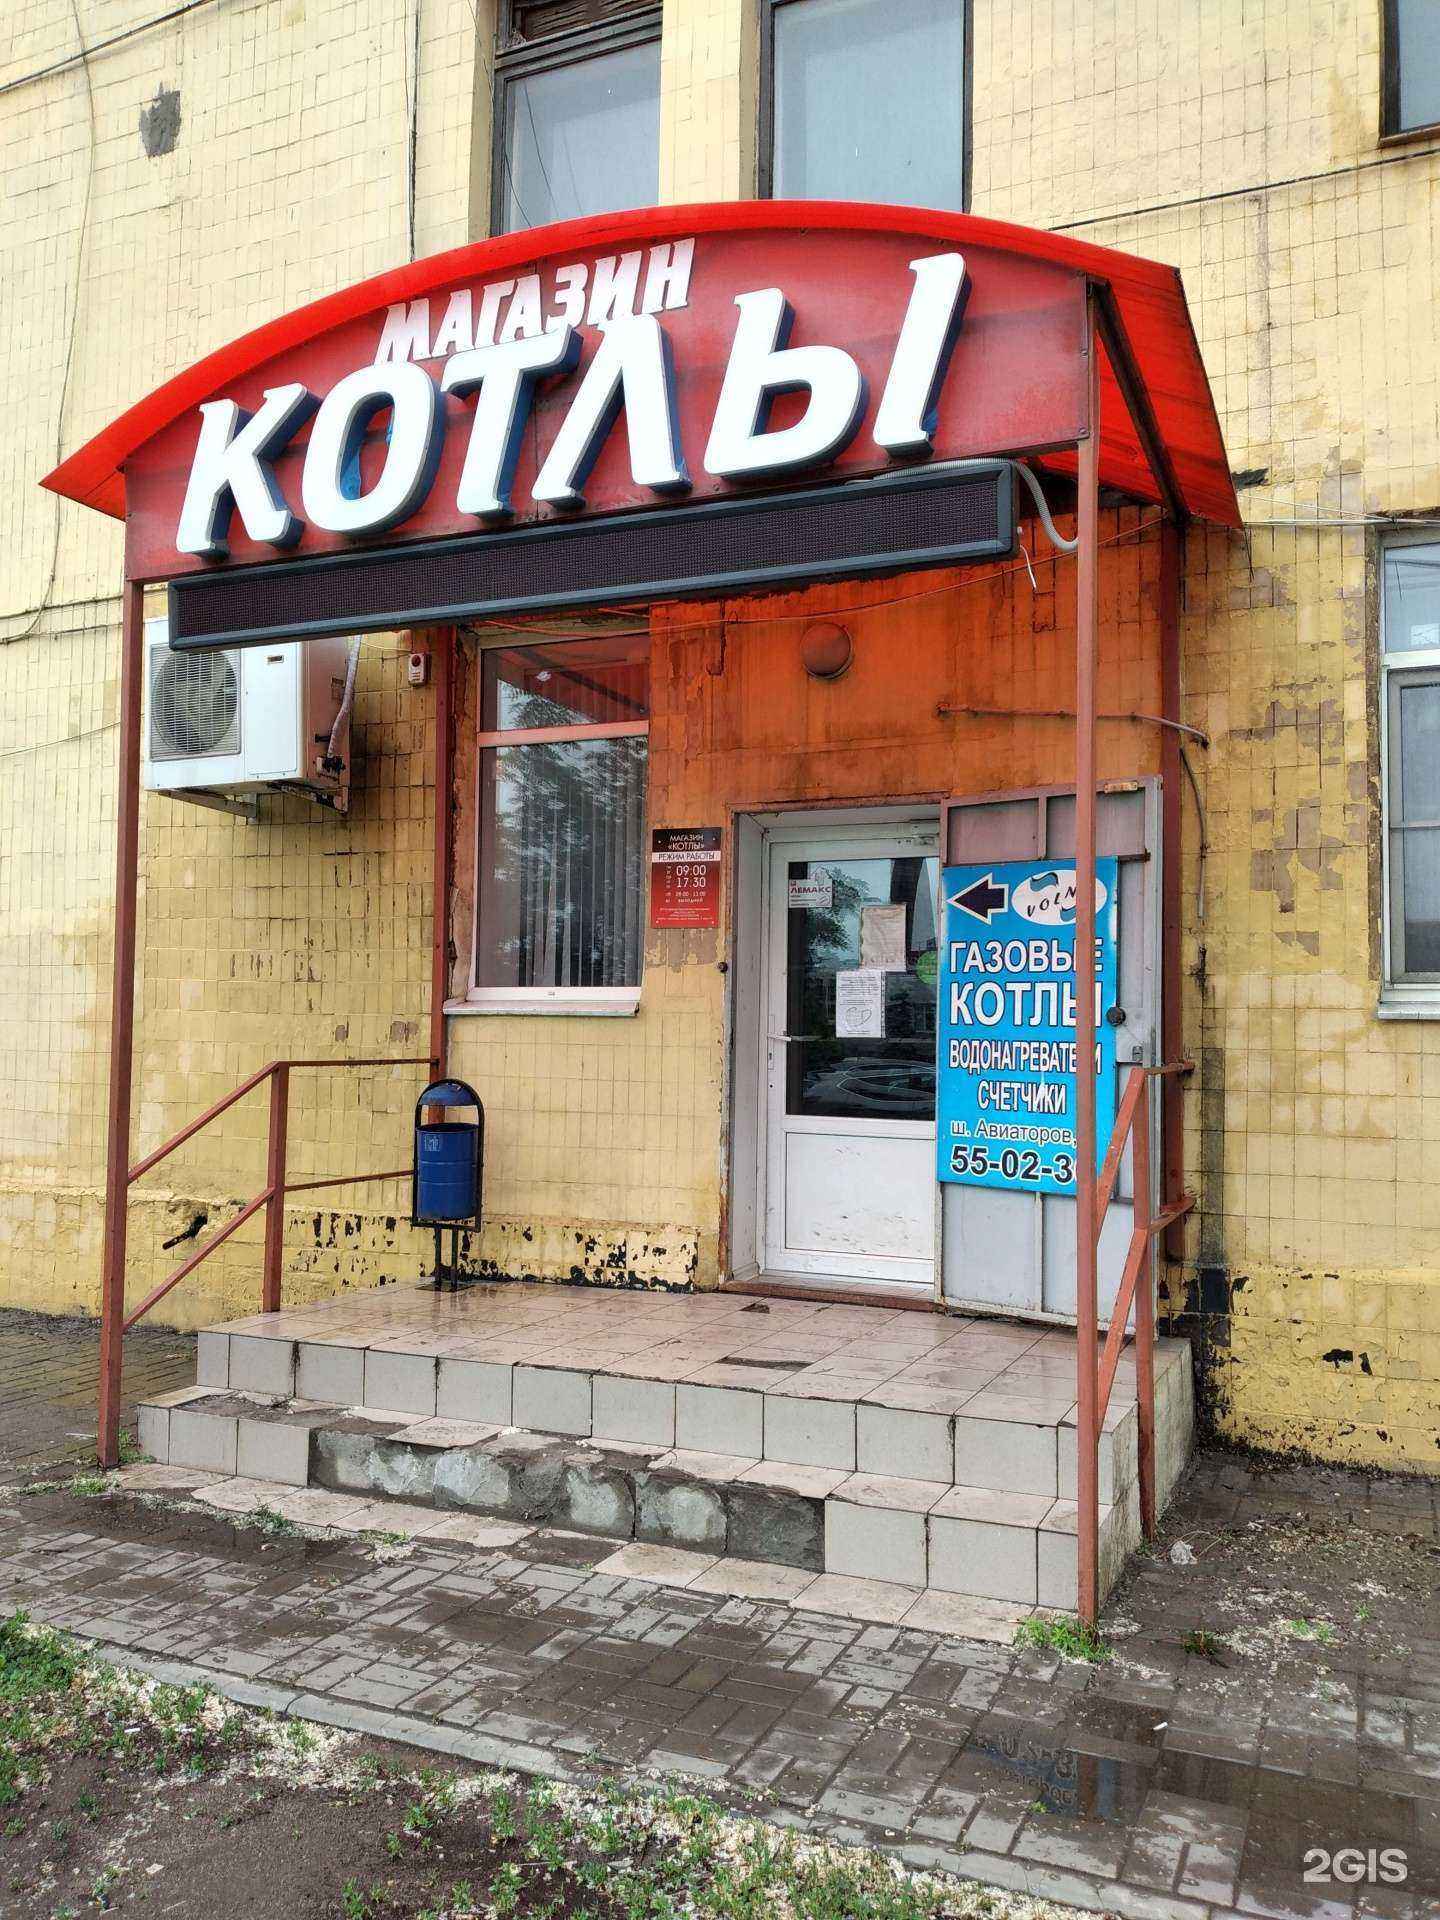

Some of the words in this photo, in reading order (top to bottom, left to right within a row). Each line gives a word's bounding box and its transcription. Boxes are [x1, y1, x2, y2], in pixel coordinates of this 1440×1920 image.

[374, 236, 697, 364] МАГАЗИН
[176, 252, 968, 559] КОТЛЫ
[658, 852, 685, 861] РЕЖИМ
[686, 851, 716, 860] РАБОТЫ
[669, 833, 705, 842] МАГАЗИН
[1027, 886, 1077, 918] VOLN
[949, 1038, 1102, 1076] ВОДОНАГРЕВАТЕ
[977, 1079, 1067, 1116] СЧЕТЧИКИ
[951, 1120, 970, 1138] ш.
[976, 1118, 1077, 1147] Авиаторов,
[950, 1145, 1077, 1185] 55-02-3
